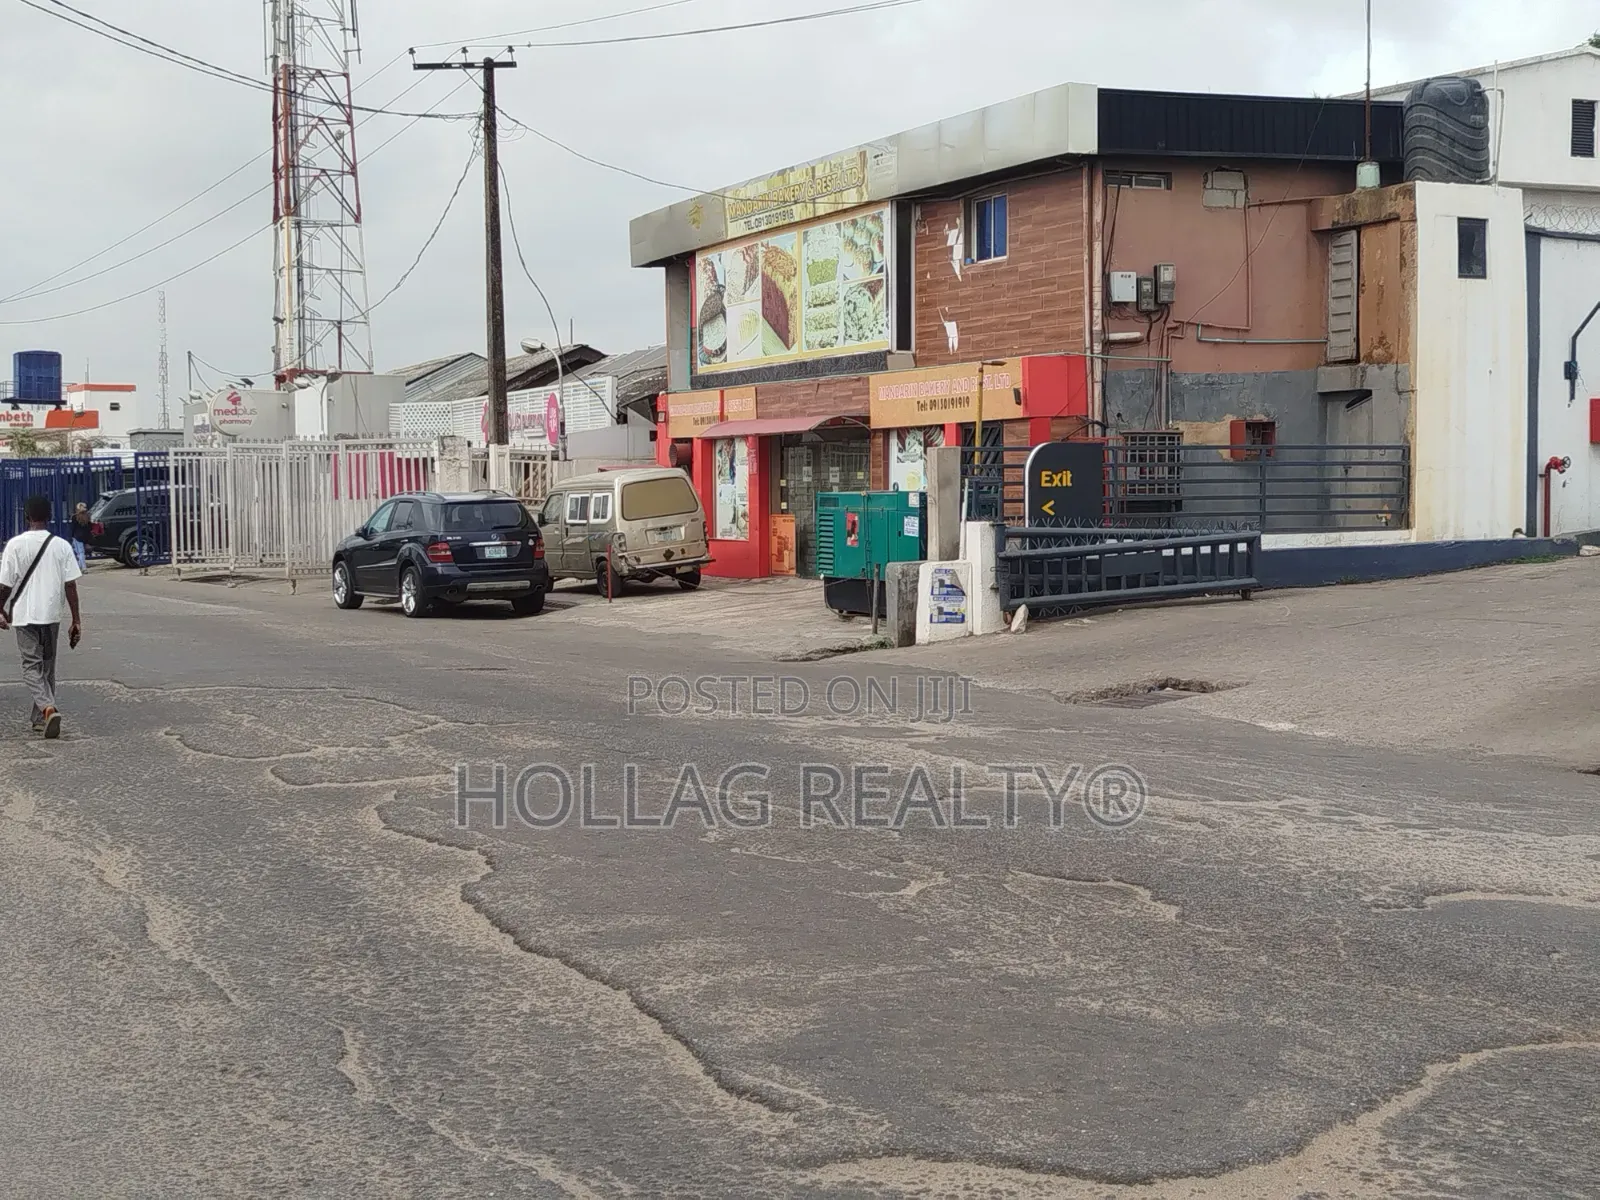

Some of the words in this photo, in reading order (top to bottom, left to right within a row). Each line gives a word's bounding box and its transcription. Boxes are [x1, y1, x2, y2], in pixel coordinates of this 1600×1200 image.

[771, 181, 806, 210] BAKERY
[806, 178, 817, 200] &
[878, 382, 918, 401] MANDARIN
[918, 379, 950, 397] BAKERY
[951, 377, 970, 394] AND
[994, 372, 1012, 389] LTD
[213, 406, 258, 418] medplus
[916, 400, 928, 412] Tel:
[219, 418, 253, 426] pharmacy
[1041, 470, 1073, 487] Exit
